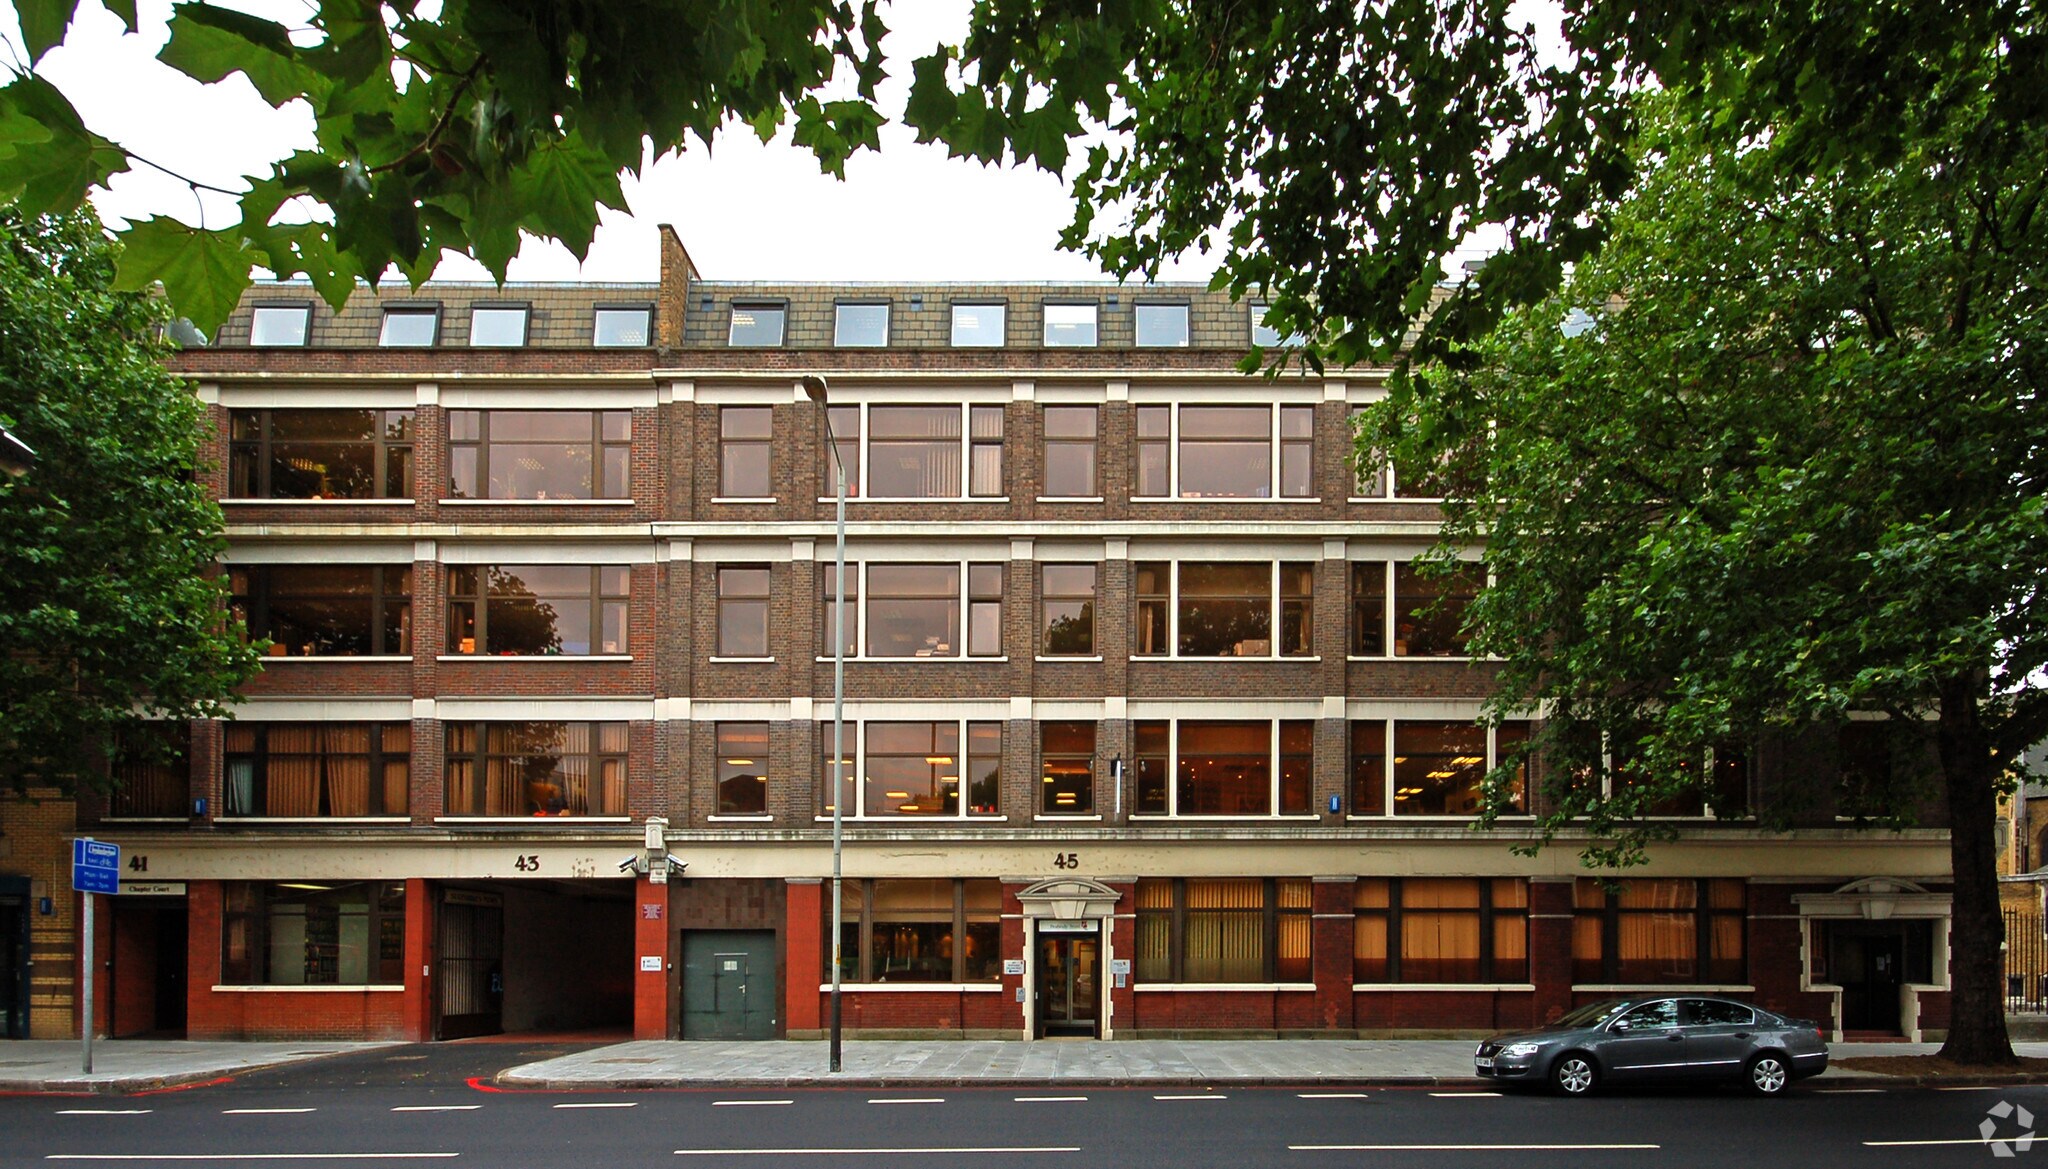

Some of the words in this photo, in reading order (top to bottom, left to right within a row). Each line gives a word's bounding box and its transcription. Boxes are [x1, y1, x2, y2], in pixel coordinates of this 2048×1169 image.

[128, 855, 148, 871] 41
[515, 854, 540, 872] 43
[1054, 852, 1079, 869] 45
[129, 885, 151, 893] Chapter
